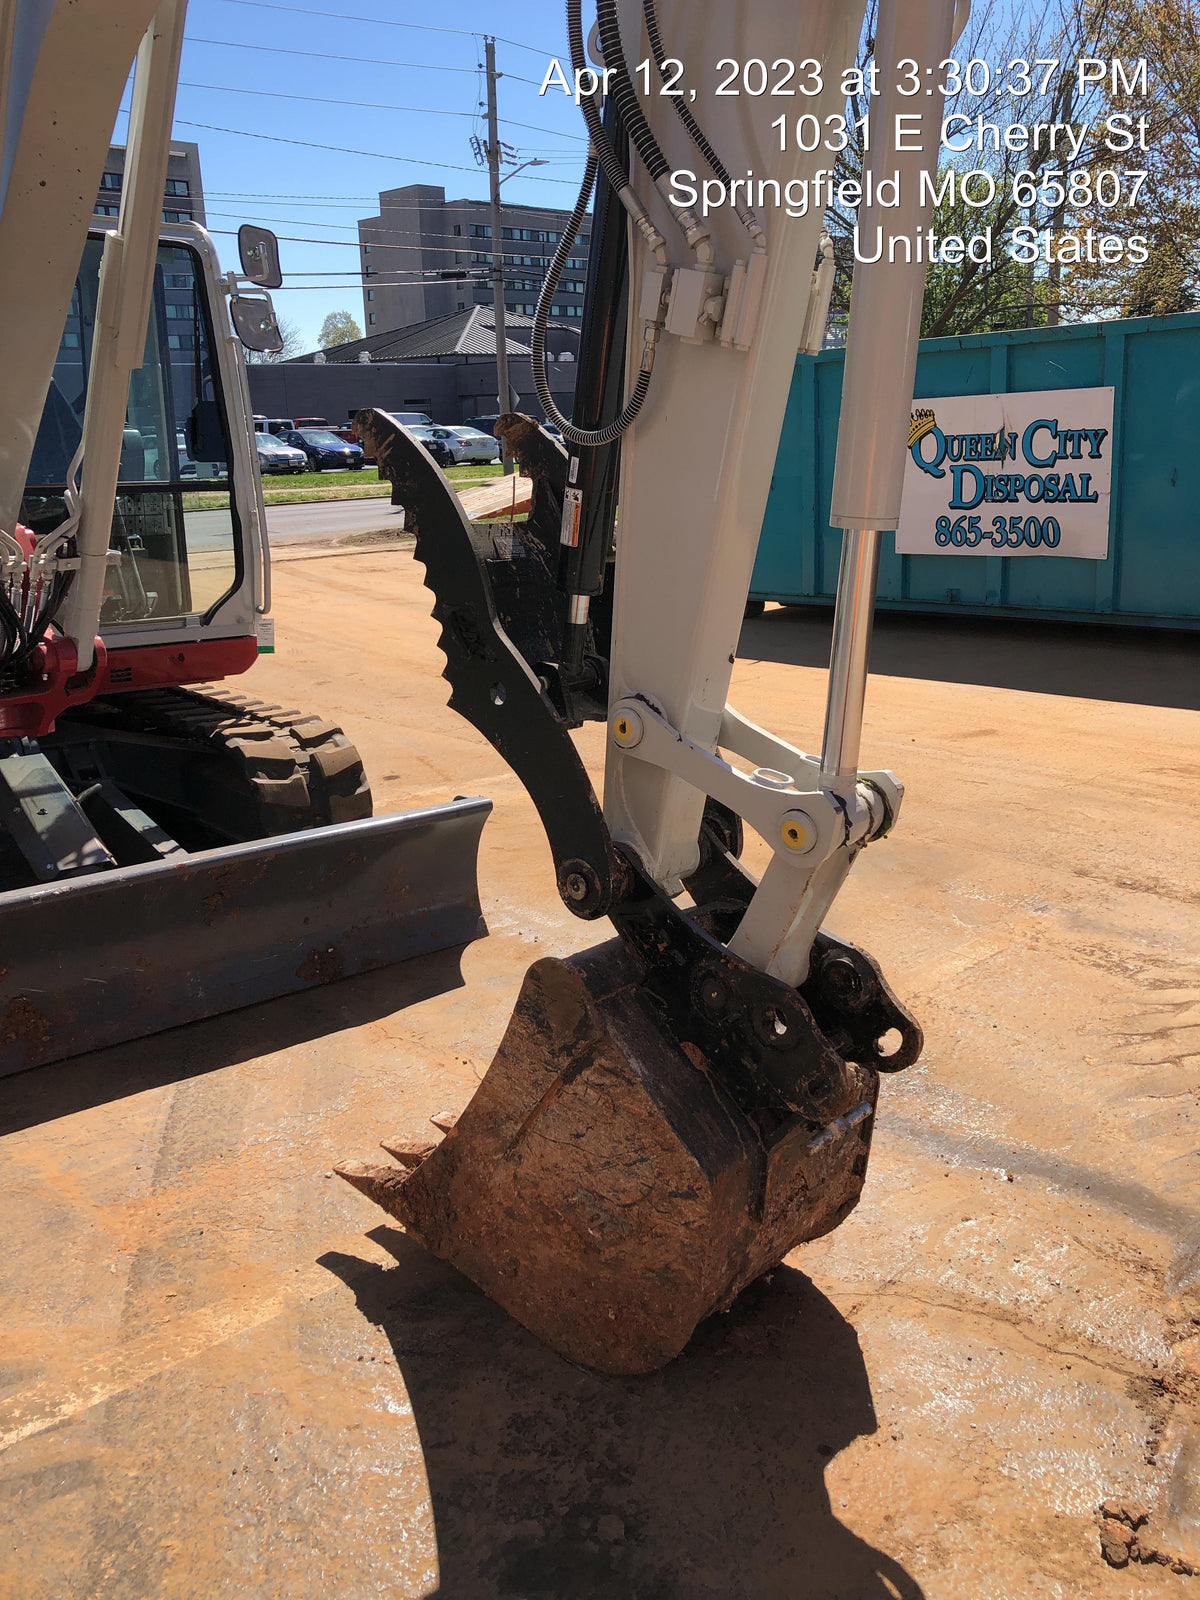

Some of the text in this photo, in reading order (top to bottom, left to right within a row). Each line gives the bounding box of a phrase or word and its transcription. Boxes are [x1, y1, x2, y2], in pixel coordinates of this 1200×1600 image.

[1022, 419, 1108, 468] CITY
[949, 464, 1098, 510] DISPOSAL
[935, 515, 1061, 548] 865-3500
